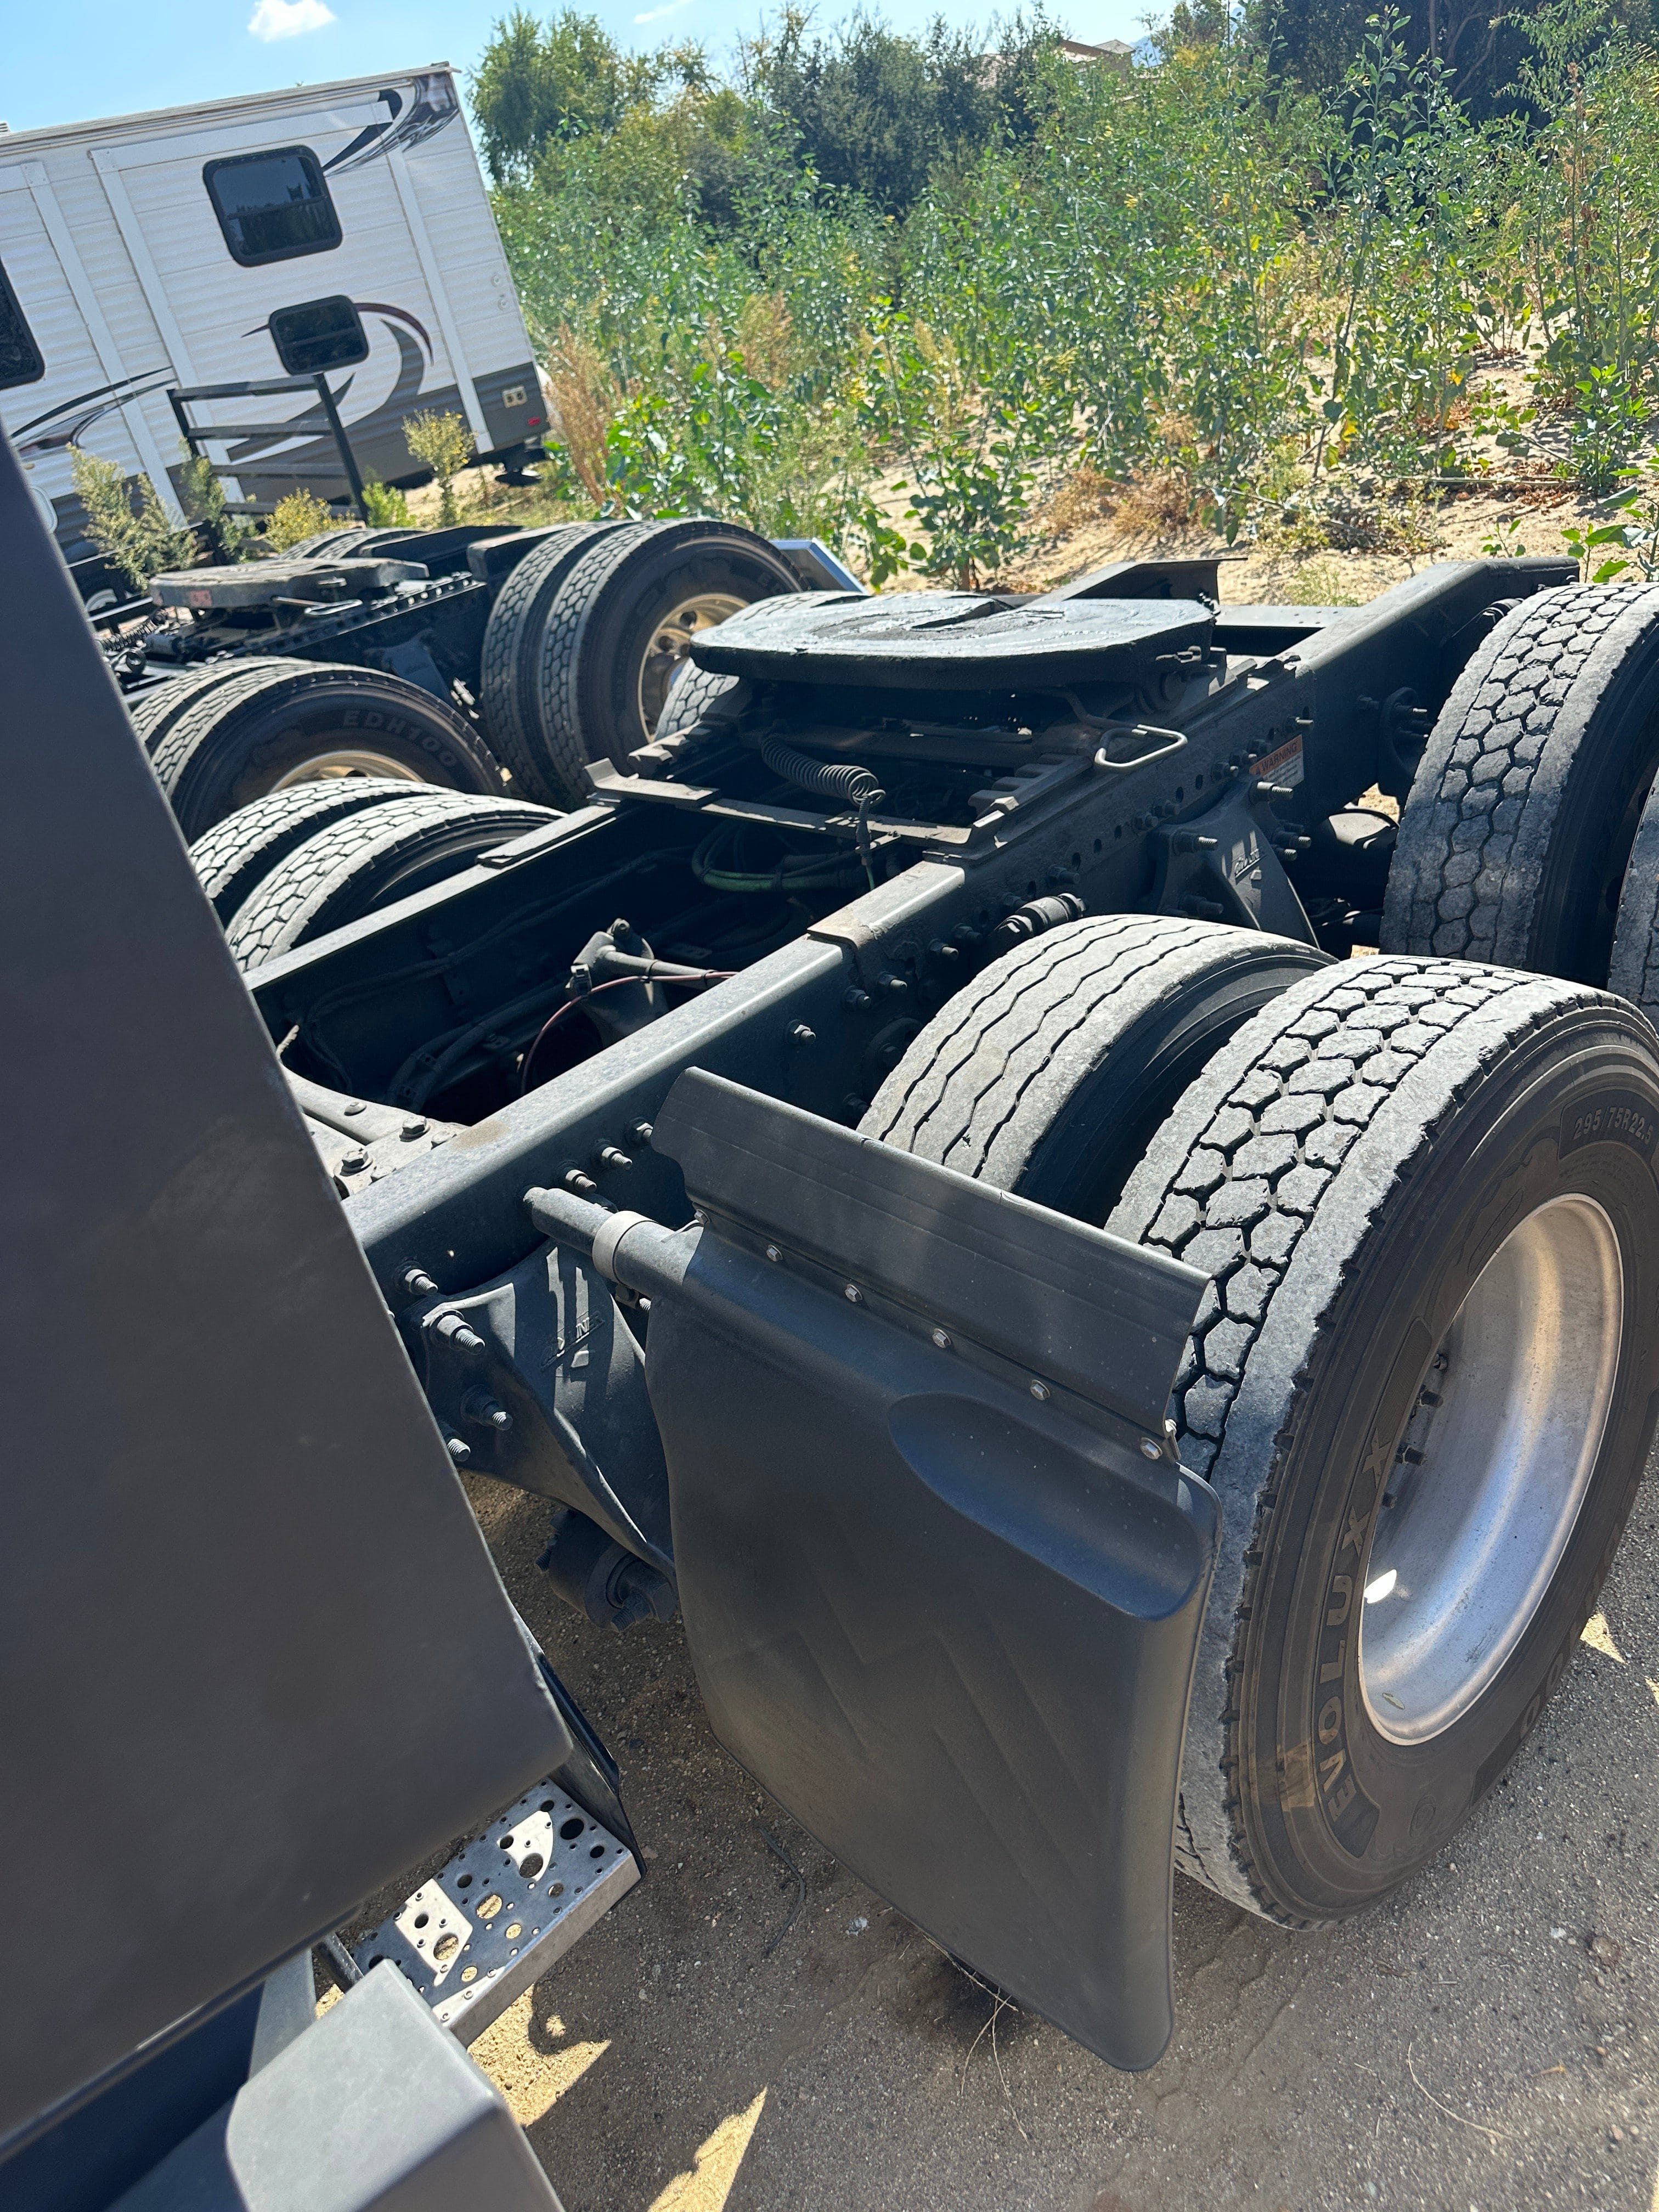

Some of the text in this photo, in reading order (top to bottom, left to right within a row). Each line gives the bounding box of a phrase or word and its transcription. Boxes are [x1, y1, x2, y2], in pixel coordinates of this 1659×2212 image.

[342, 709, 458, 767] EDH100
[1262, 742, 1297, 771] WARNING
[1573, 1107, 1654, 1144] 295/75R22.5
[1318, 1428, 1391, 1821] EVOLUXX
